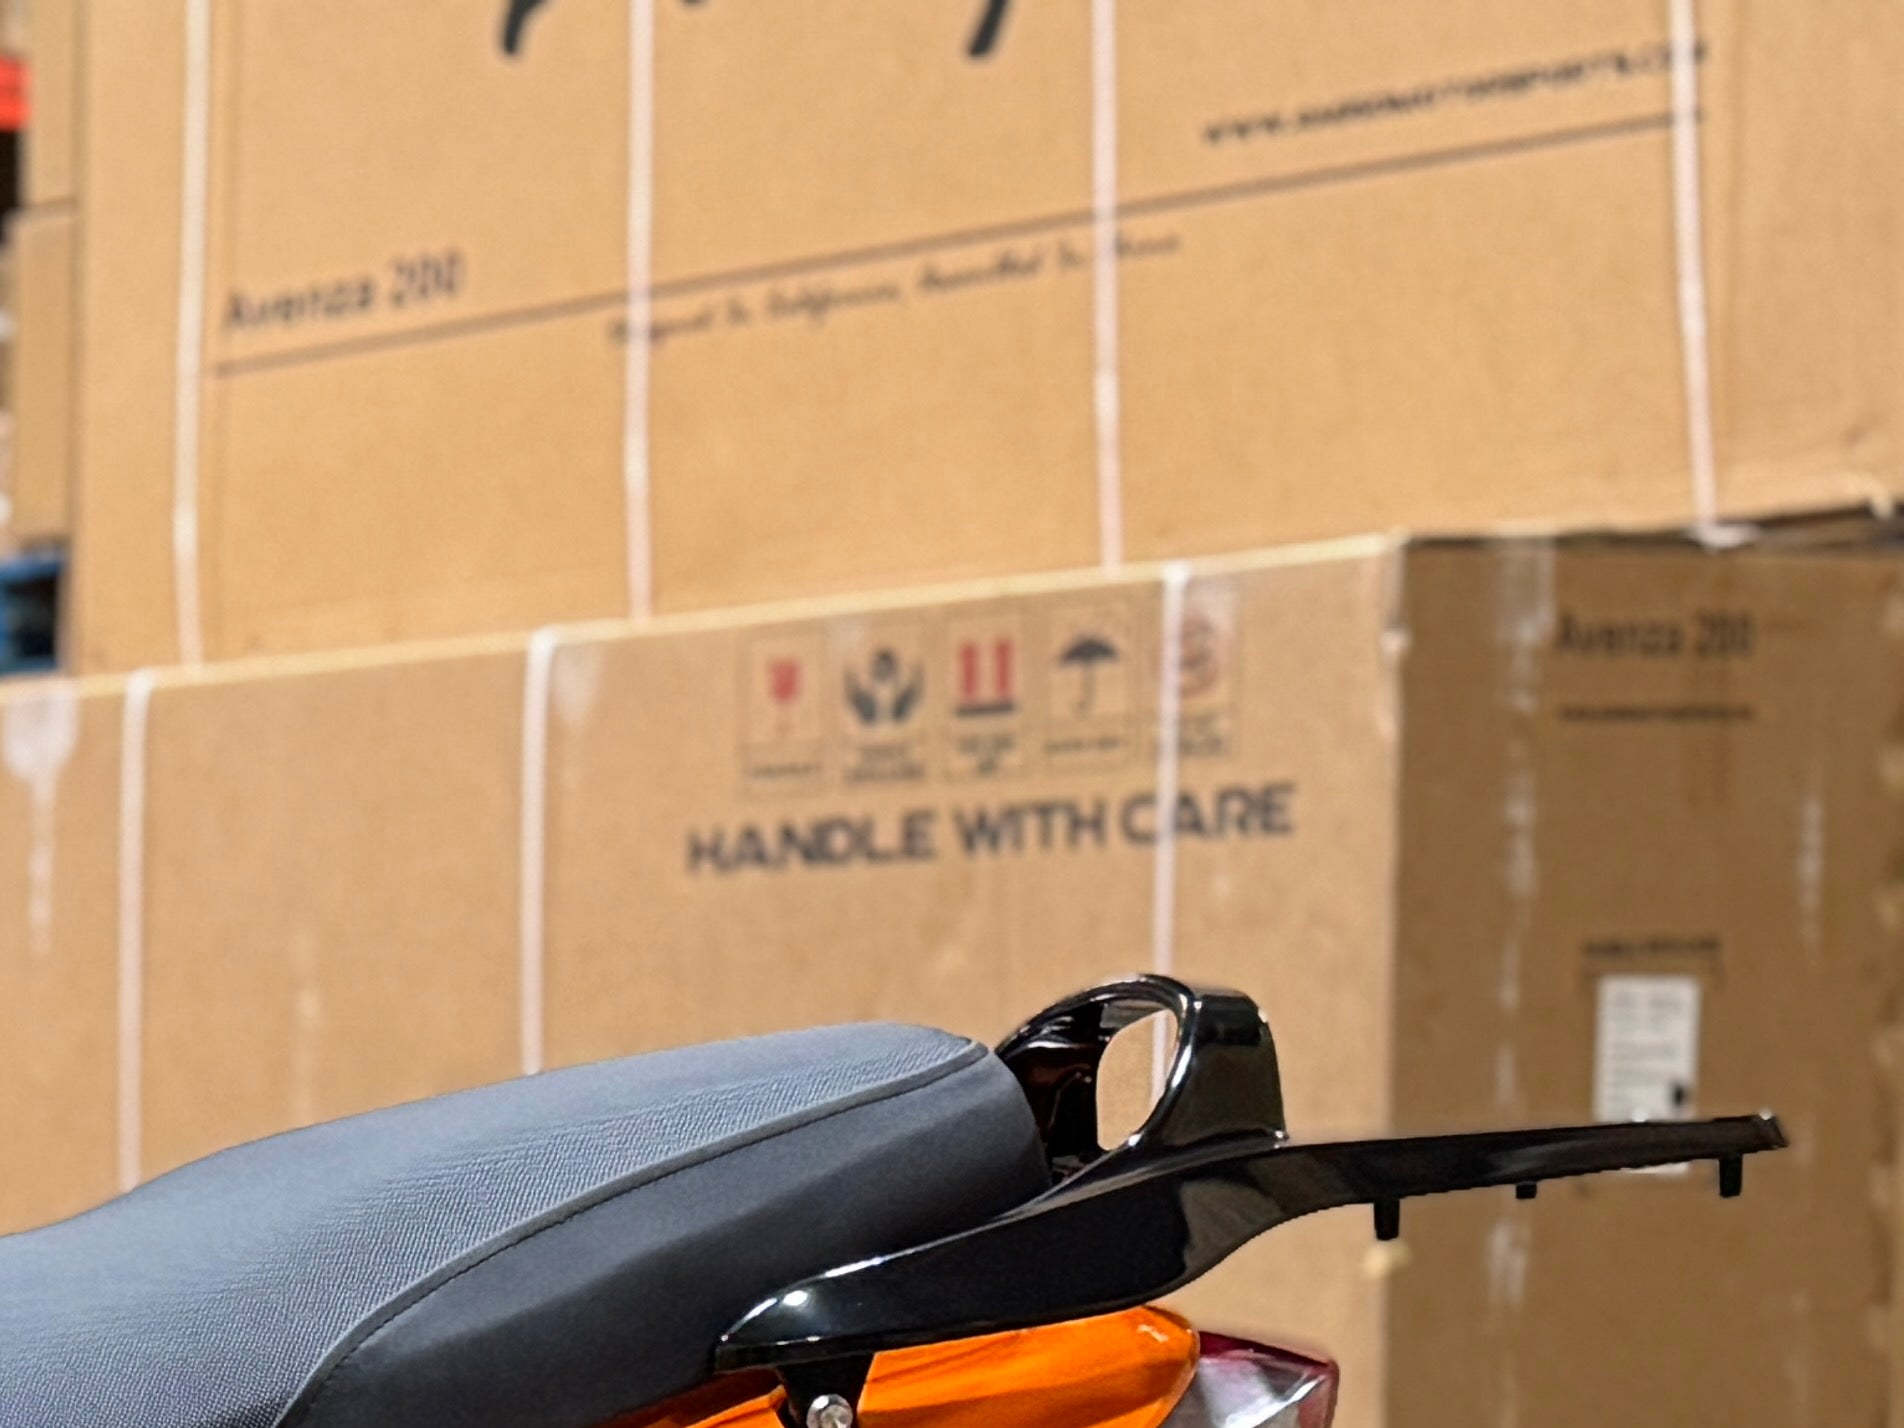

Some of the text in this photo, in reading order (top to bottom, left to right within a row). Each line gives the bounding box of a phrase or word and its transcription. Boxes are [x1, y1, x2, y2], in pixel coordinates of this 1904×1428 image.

[685, 782, 1299, 873] HANDLE WITH CARE
